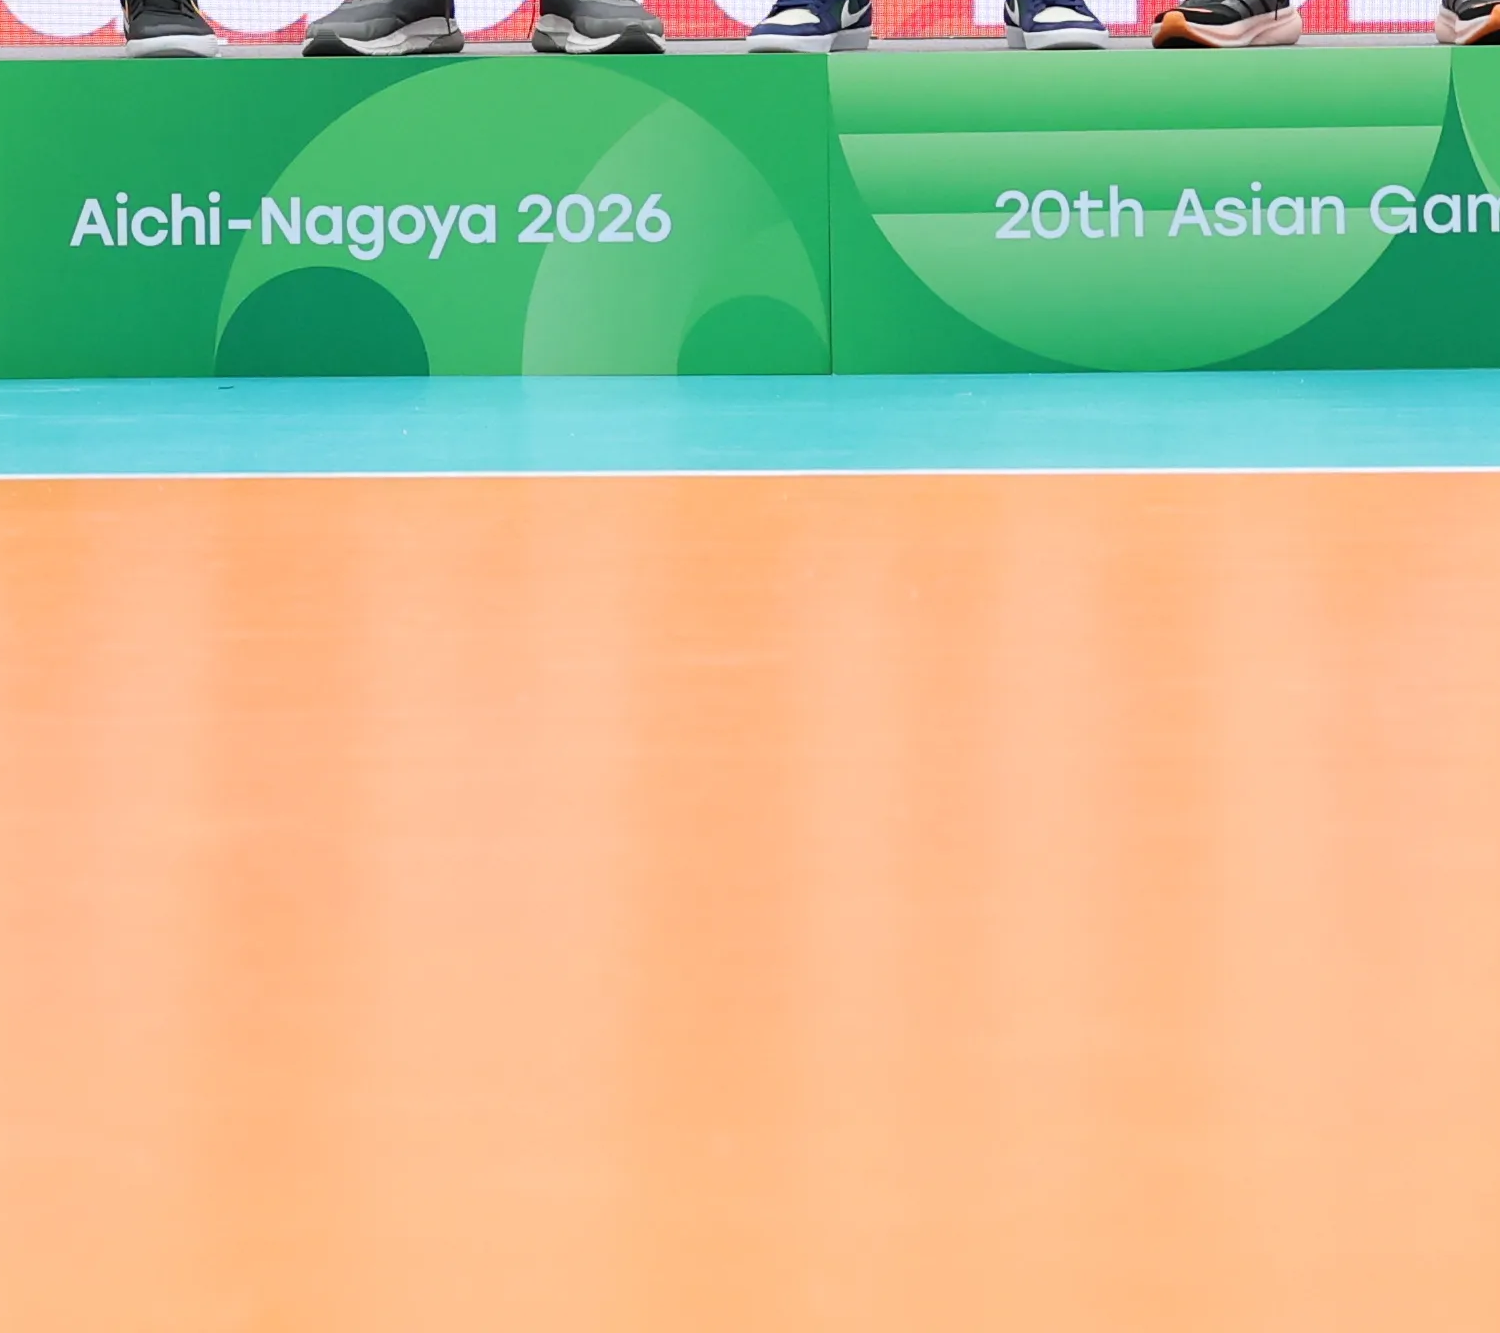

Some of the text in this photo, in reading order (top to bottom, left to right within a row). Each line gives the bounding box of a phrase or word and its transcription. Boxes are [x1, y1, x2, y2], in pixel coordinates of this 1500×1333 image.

[70, 191, 671, 261] Aichi-Nagoya 2026
[995, 185, 1144, 239] 20th
[1168, 181, 1346, 237] Asian
